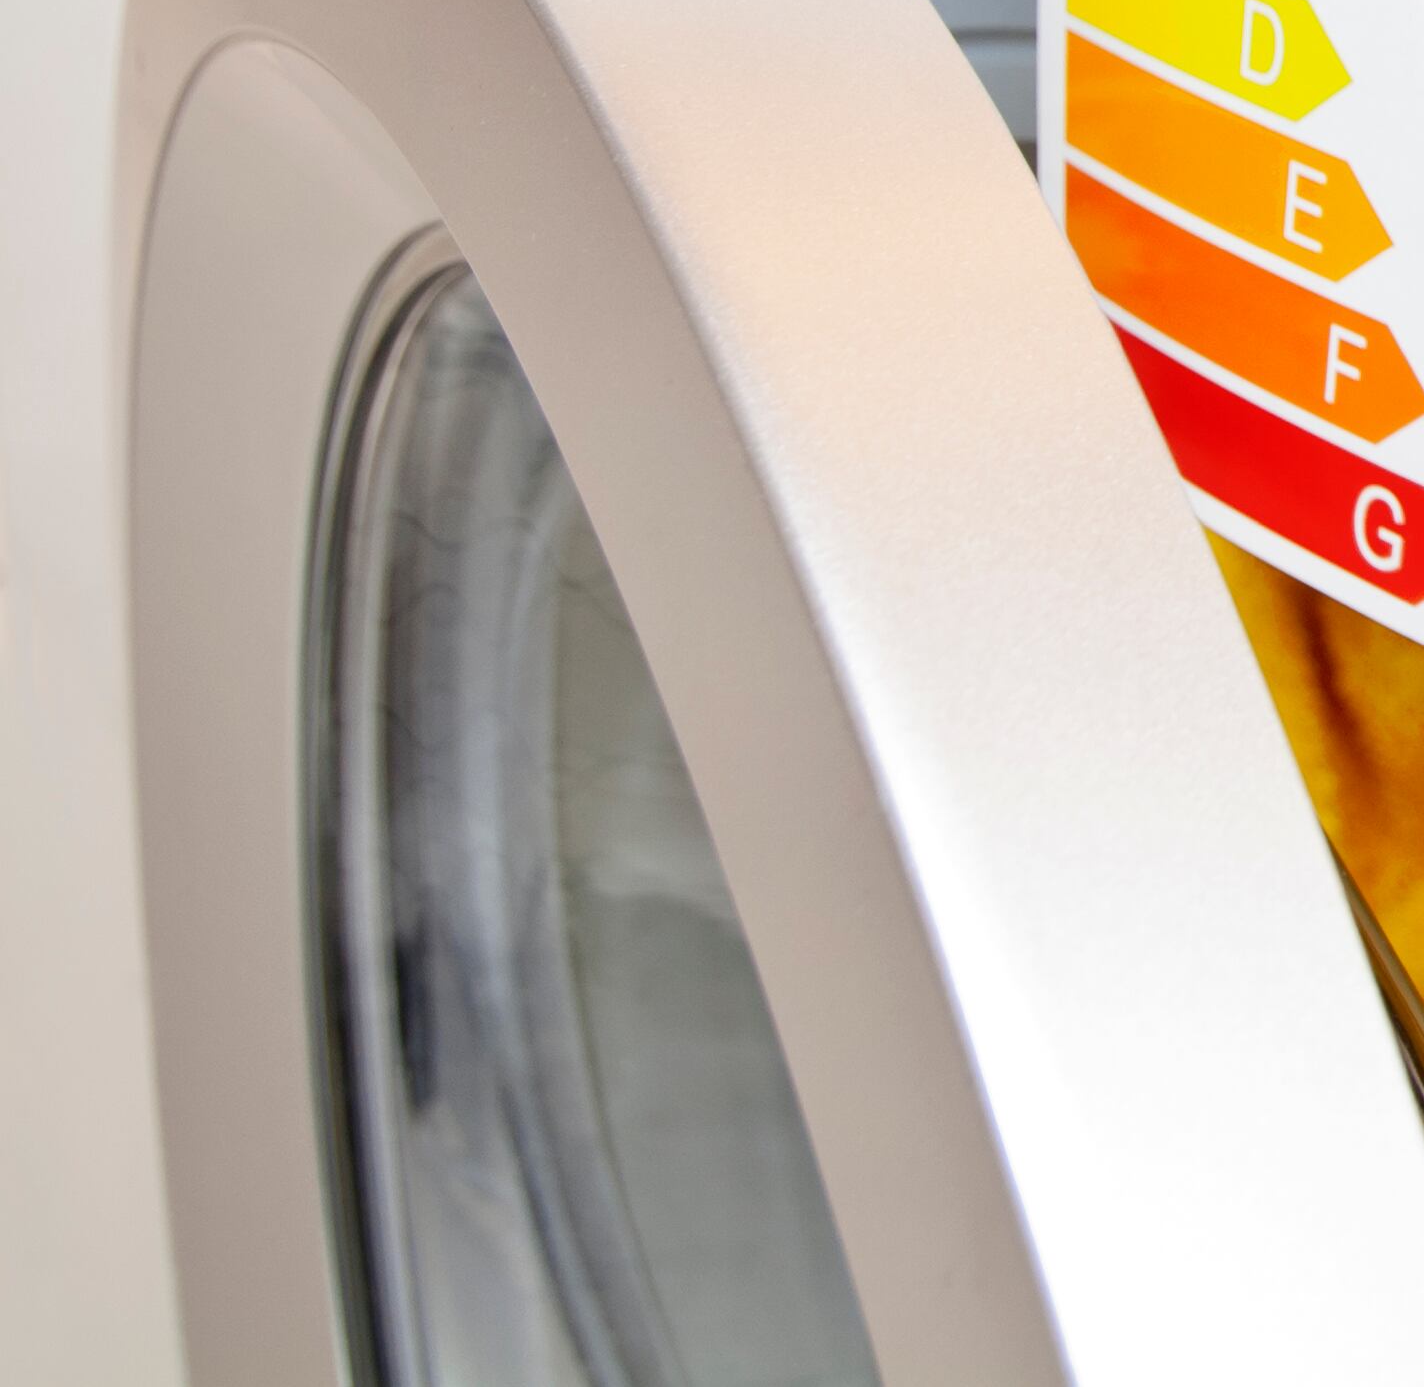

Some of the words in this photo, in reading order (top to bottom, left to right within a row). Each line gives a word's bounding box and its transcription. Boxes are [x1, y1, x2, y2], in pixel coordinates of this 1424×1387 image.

[1282, 159, 1328, 255] E
[1322, 321, 1369, 405] F
[1352, 484, 1406, 574] G
